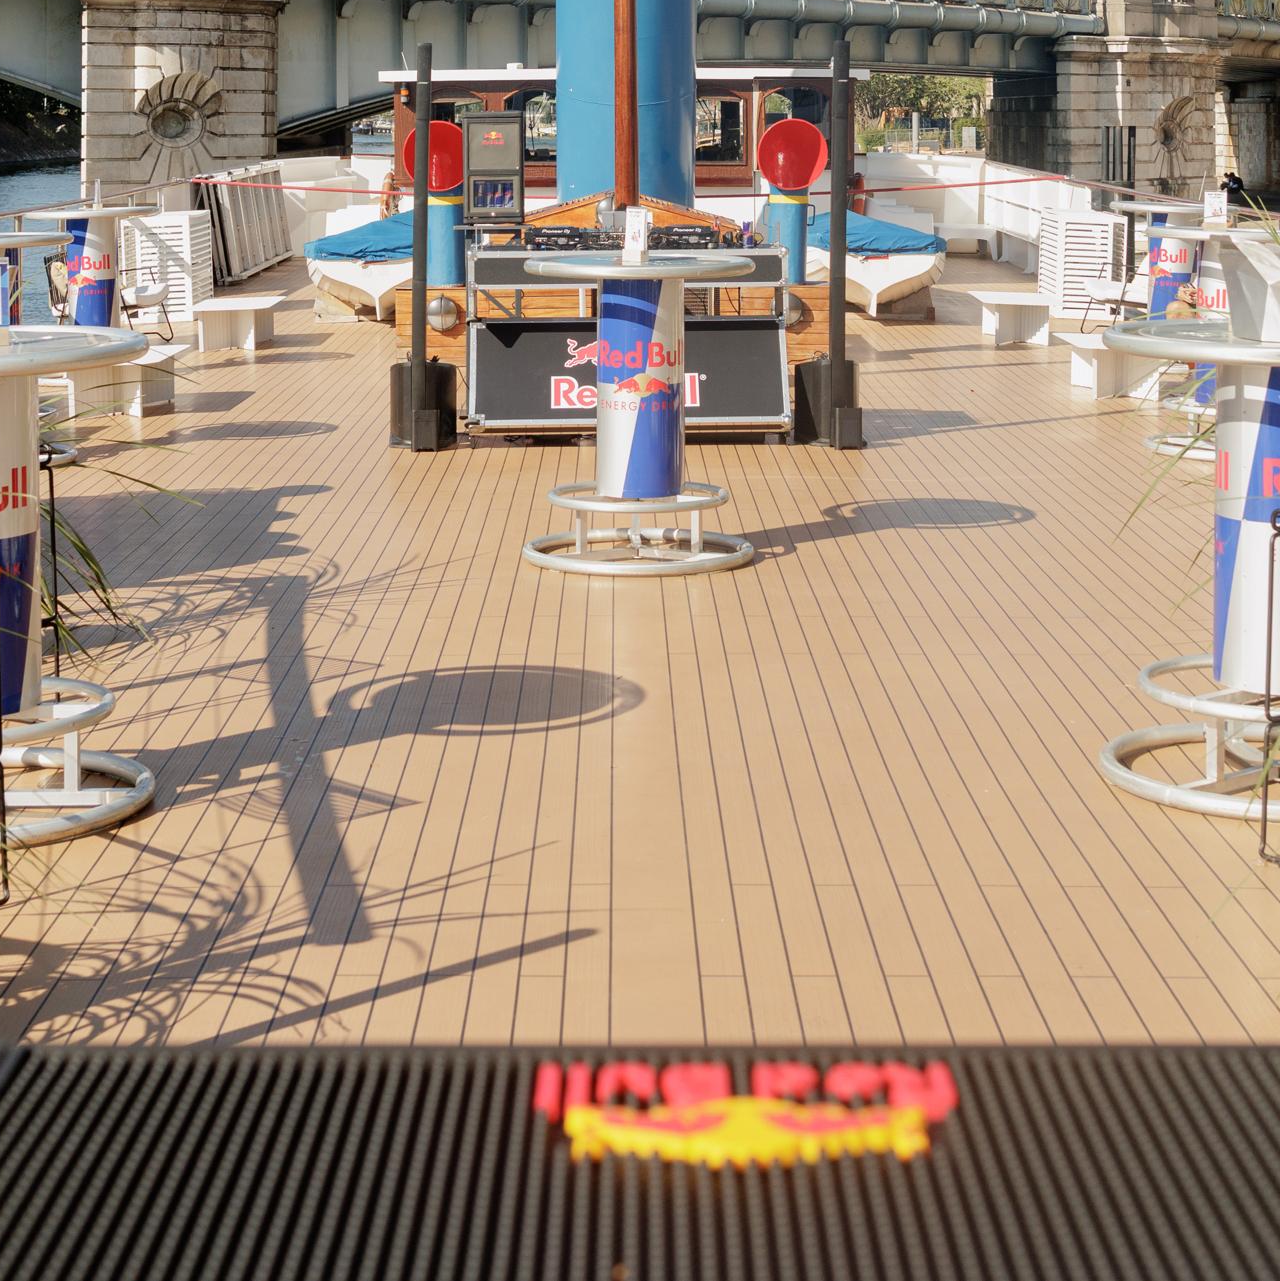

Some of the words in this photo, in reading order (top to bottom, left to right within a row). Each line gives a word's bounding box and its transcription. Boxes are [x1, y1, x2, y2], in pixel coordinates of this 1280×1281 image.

[81, 254, 111, 270] Bull
[1160, 248, 1188, 263] Bull
[1197, 287, 1227, 309] Bull
[599, 340, 643, 368] Red
[648, 339, 682, 368] Bul
[551, 376, 598, 408] Re
